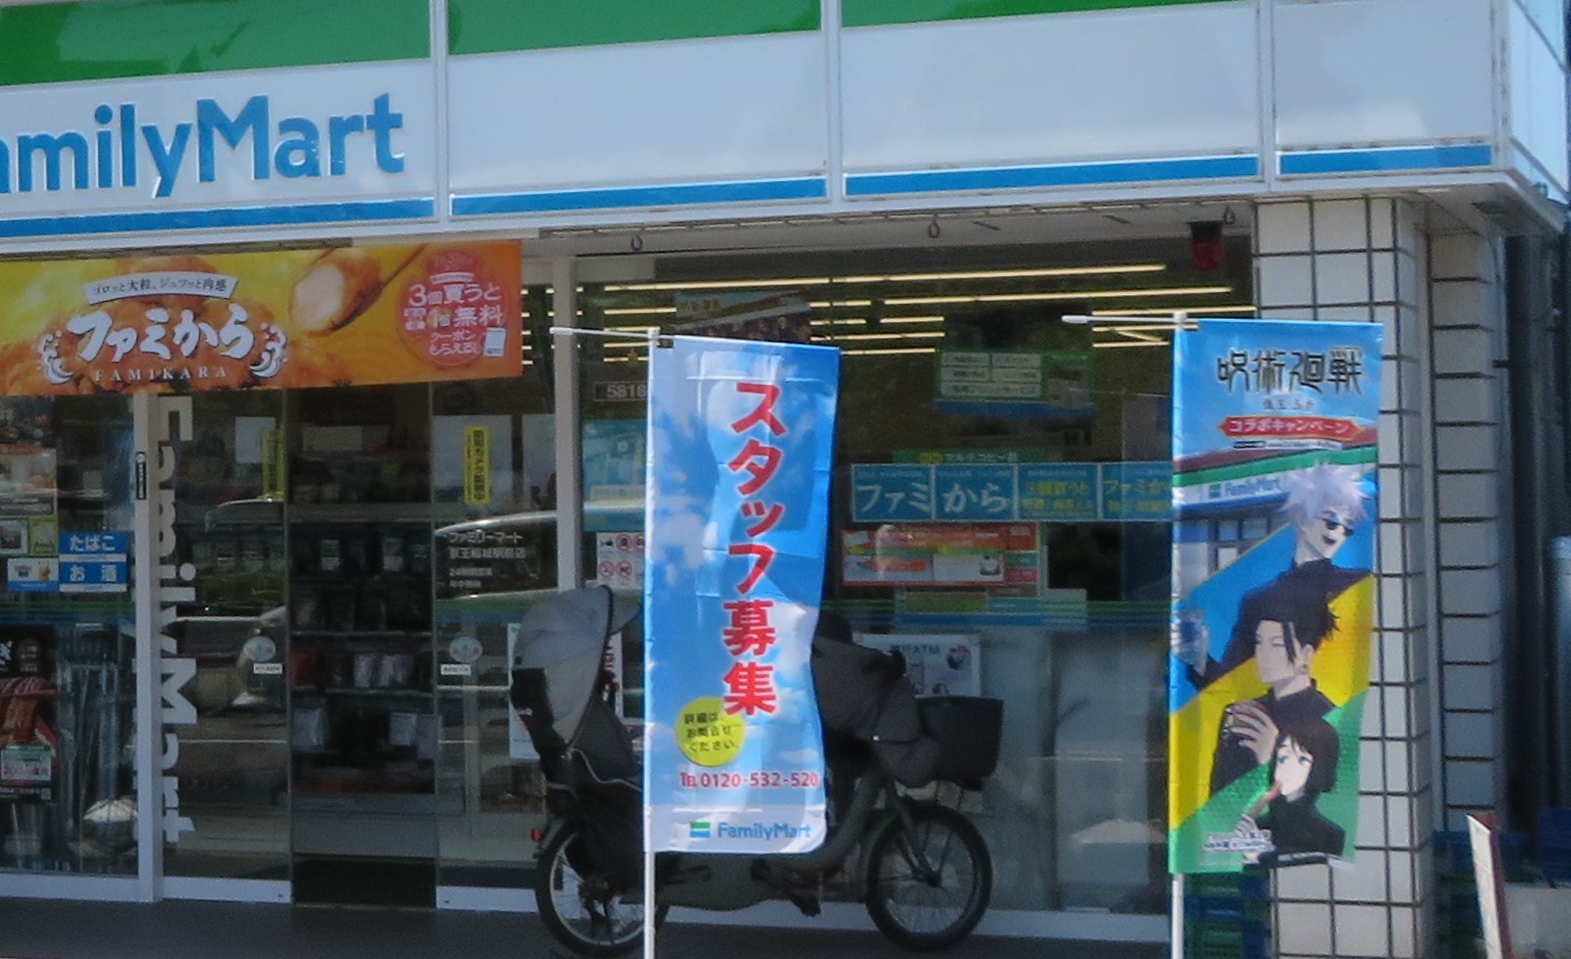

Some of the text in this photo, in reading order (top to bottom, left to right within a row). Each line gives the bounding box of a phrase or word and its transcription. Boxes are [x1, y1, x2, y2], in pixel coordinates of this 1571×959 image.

[67, 302, 255, 362] ファミから
[95, 366, 228, 382] FAMIKARA
[1217, 347, 1365, 394] 呪術廻戦
[1228, 418, 1350, 435] コラボキャンペーン
[856, 482, 1009, 515] ファミから
[69, 534, 116, 552] たばこ
[722, 381, 788, 717] スタッフ募集
[701, 772, 819, 788] 0120-532-520
[718, 822, 811, 841] FamilyMart
